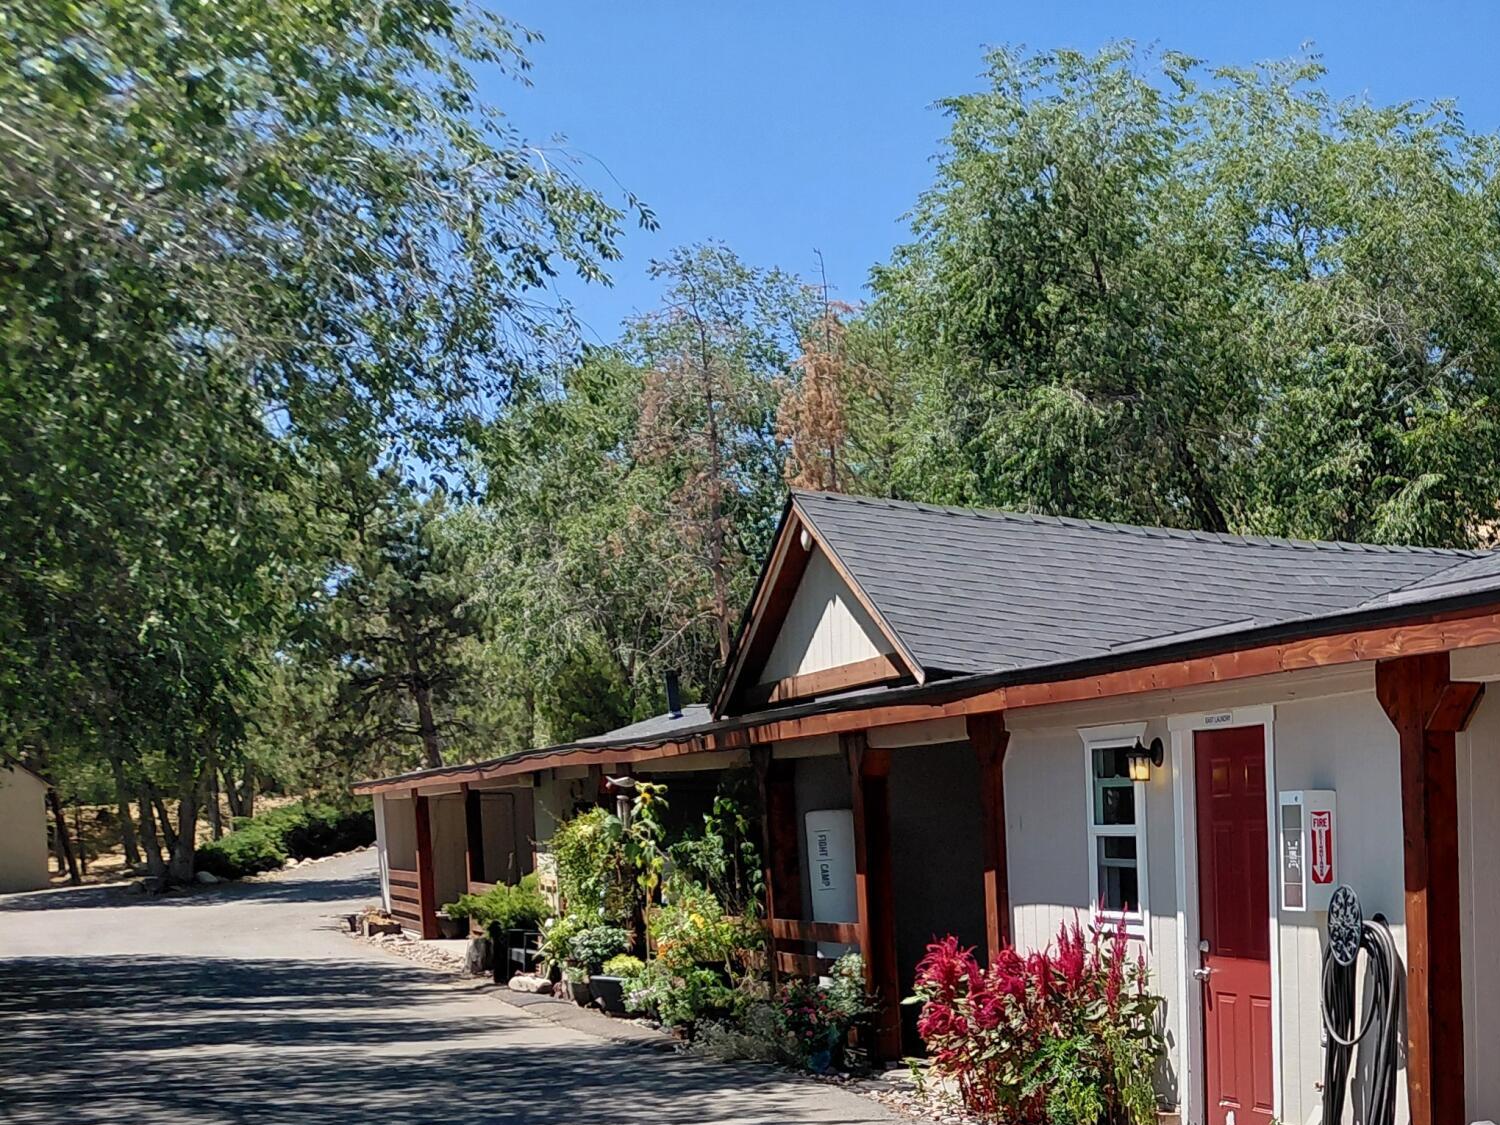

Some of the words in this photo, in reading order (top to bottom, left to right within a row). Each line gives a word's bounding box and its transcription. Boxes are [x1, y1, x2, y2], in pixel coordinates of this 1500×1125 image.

[1313, 818, 1327, 827] FIRE
[817, 834, 828, 857] FIGHT
[820, 863, 830, 887] CAMP
